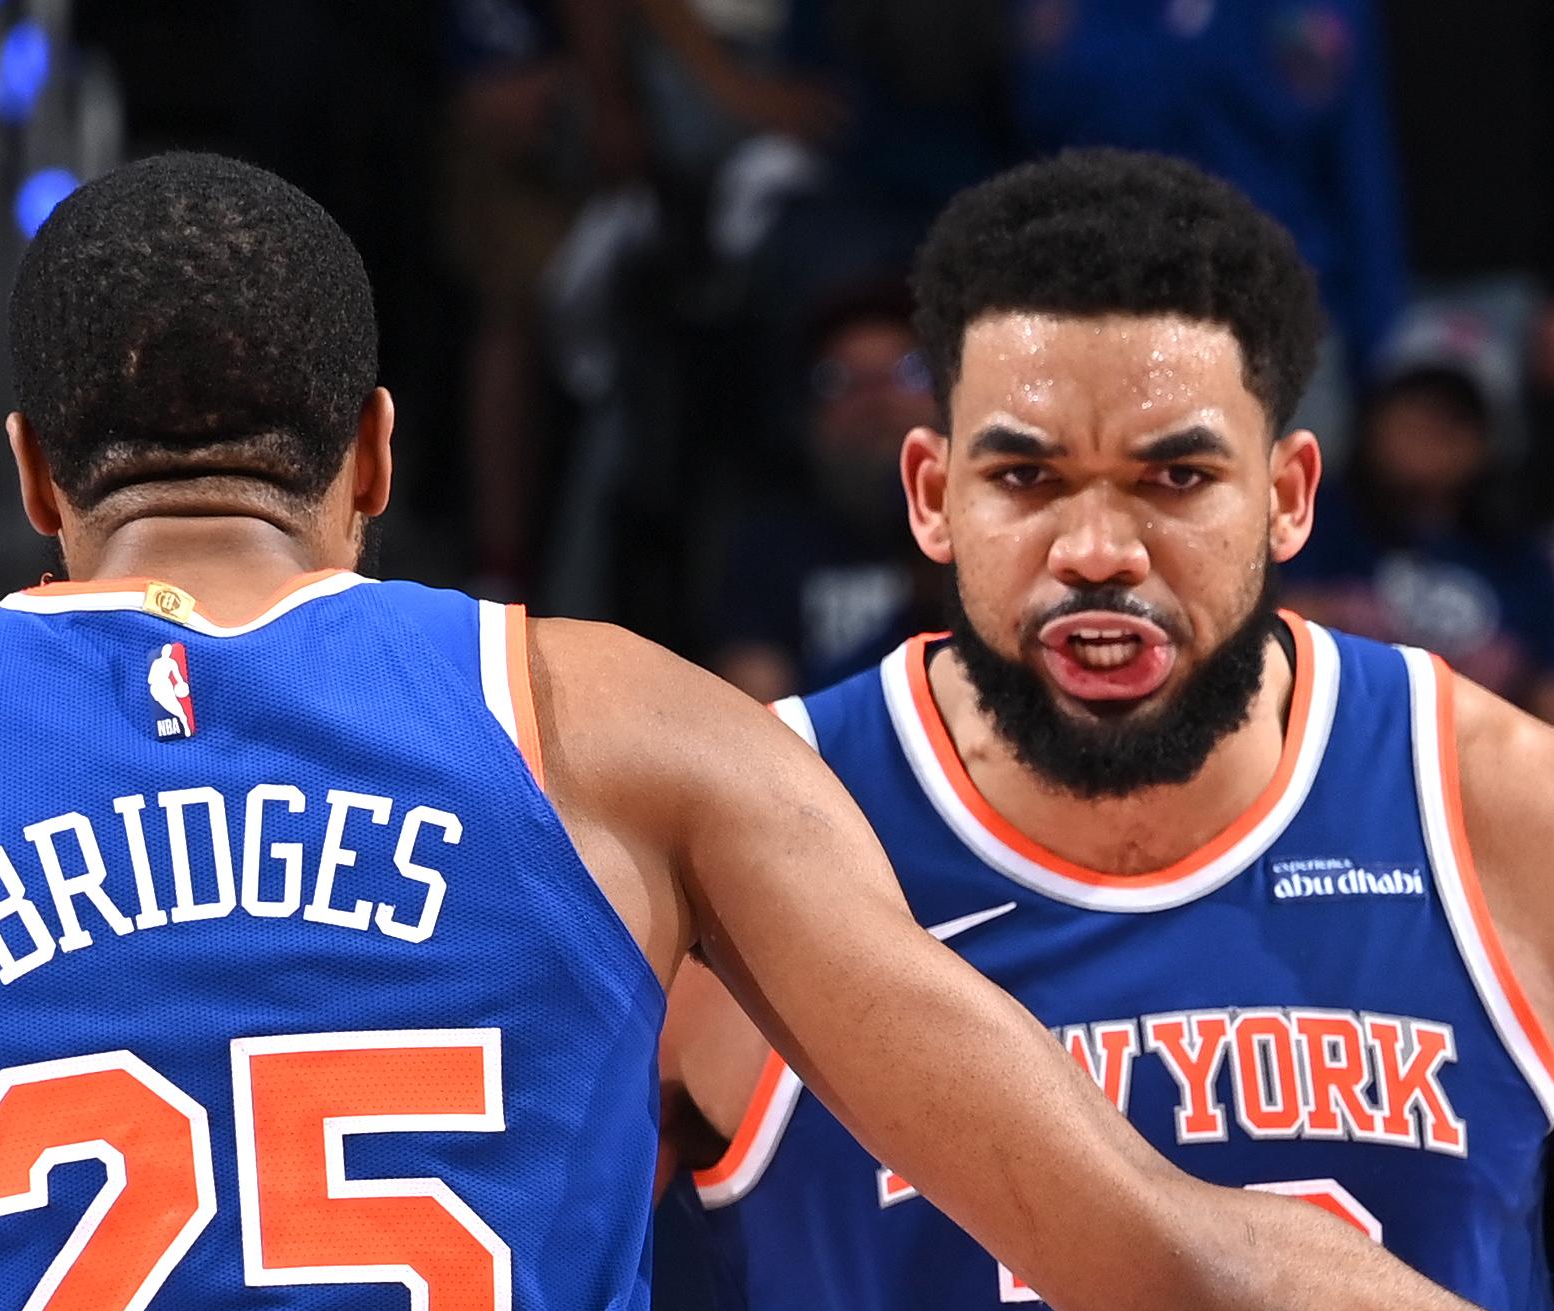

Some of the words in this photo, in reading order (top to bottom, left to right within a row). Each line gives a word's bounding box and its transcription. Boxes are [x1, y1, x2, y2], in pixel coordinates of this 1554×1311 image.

[157, 717, 181, 737] NBA
[1274, 873, 1334, 899] abu
[1337, 868, 1424, 895] dhabi
[1140, 1006, 1469, 1160] YORK
